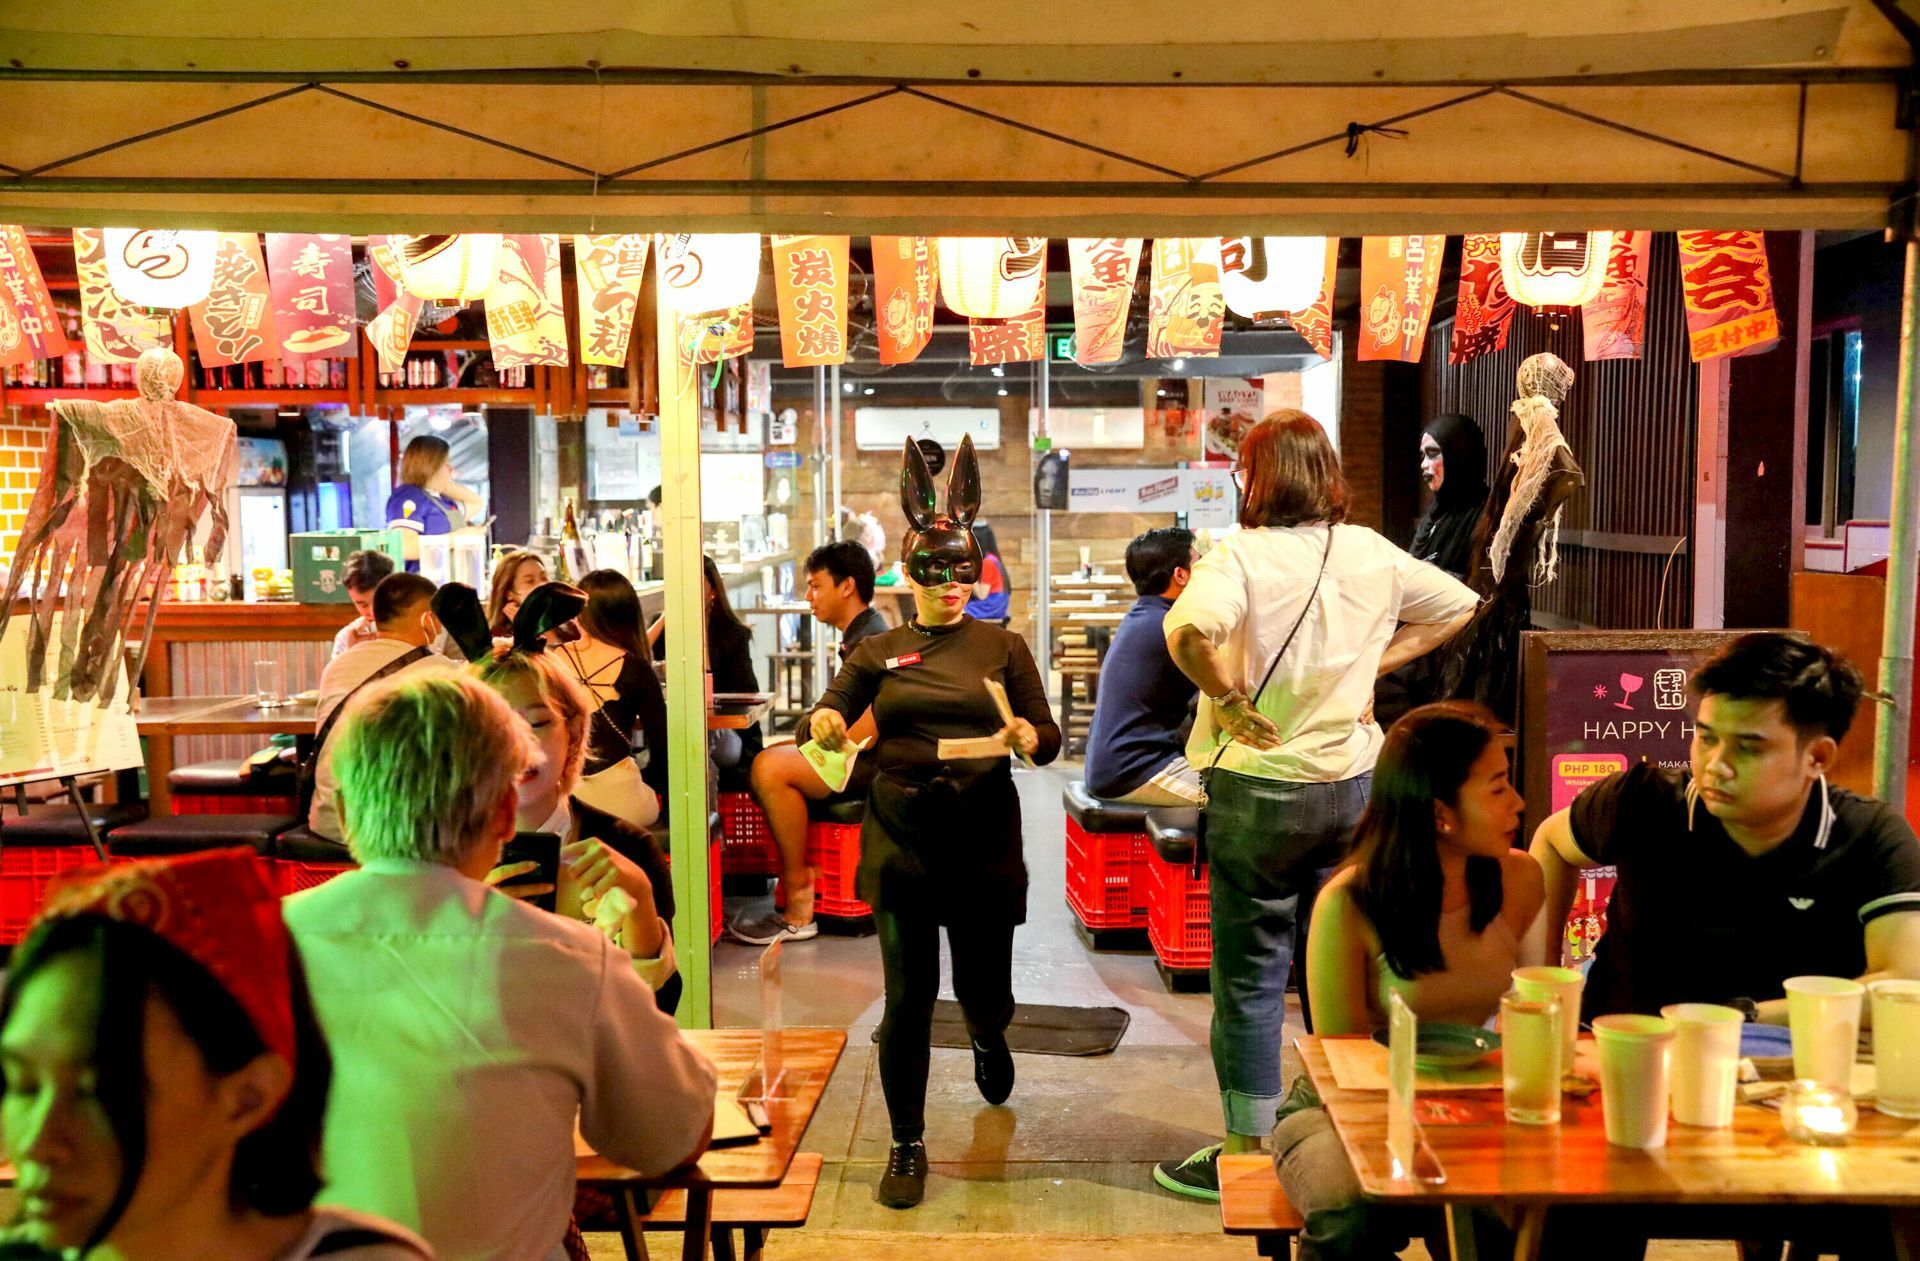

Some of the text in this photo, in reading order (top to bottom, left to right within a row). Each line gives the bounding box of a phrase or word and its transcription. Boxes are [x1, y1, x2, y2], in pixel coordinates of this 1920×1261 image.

[290, 243, 333, 316] 寿司
[1584, 721, 1697, 740] HAPPY H
[1564, 764, 1615, 774] PHP 180
[1658, 760, 1691, 768] MAKAT
